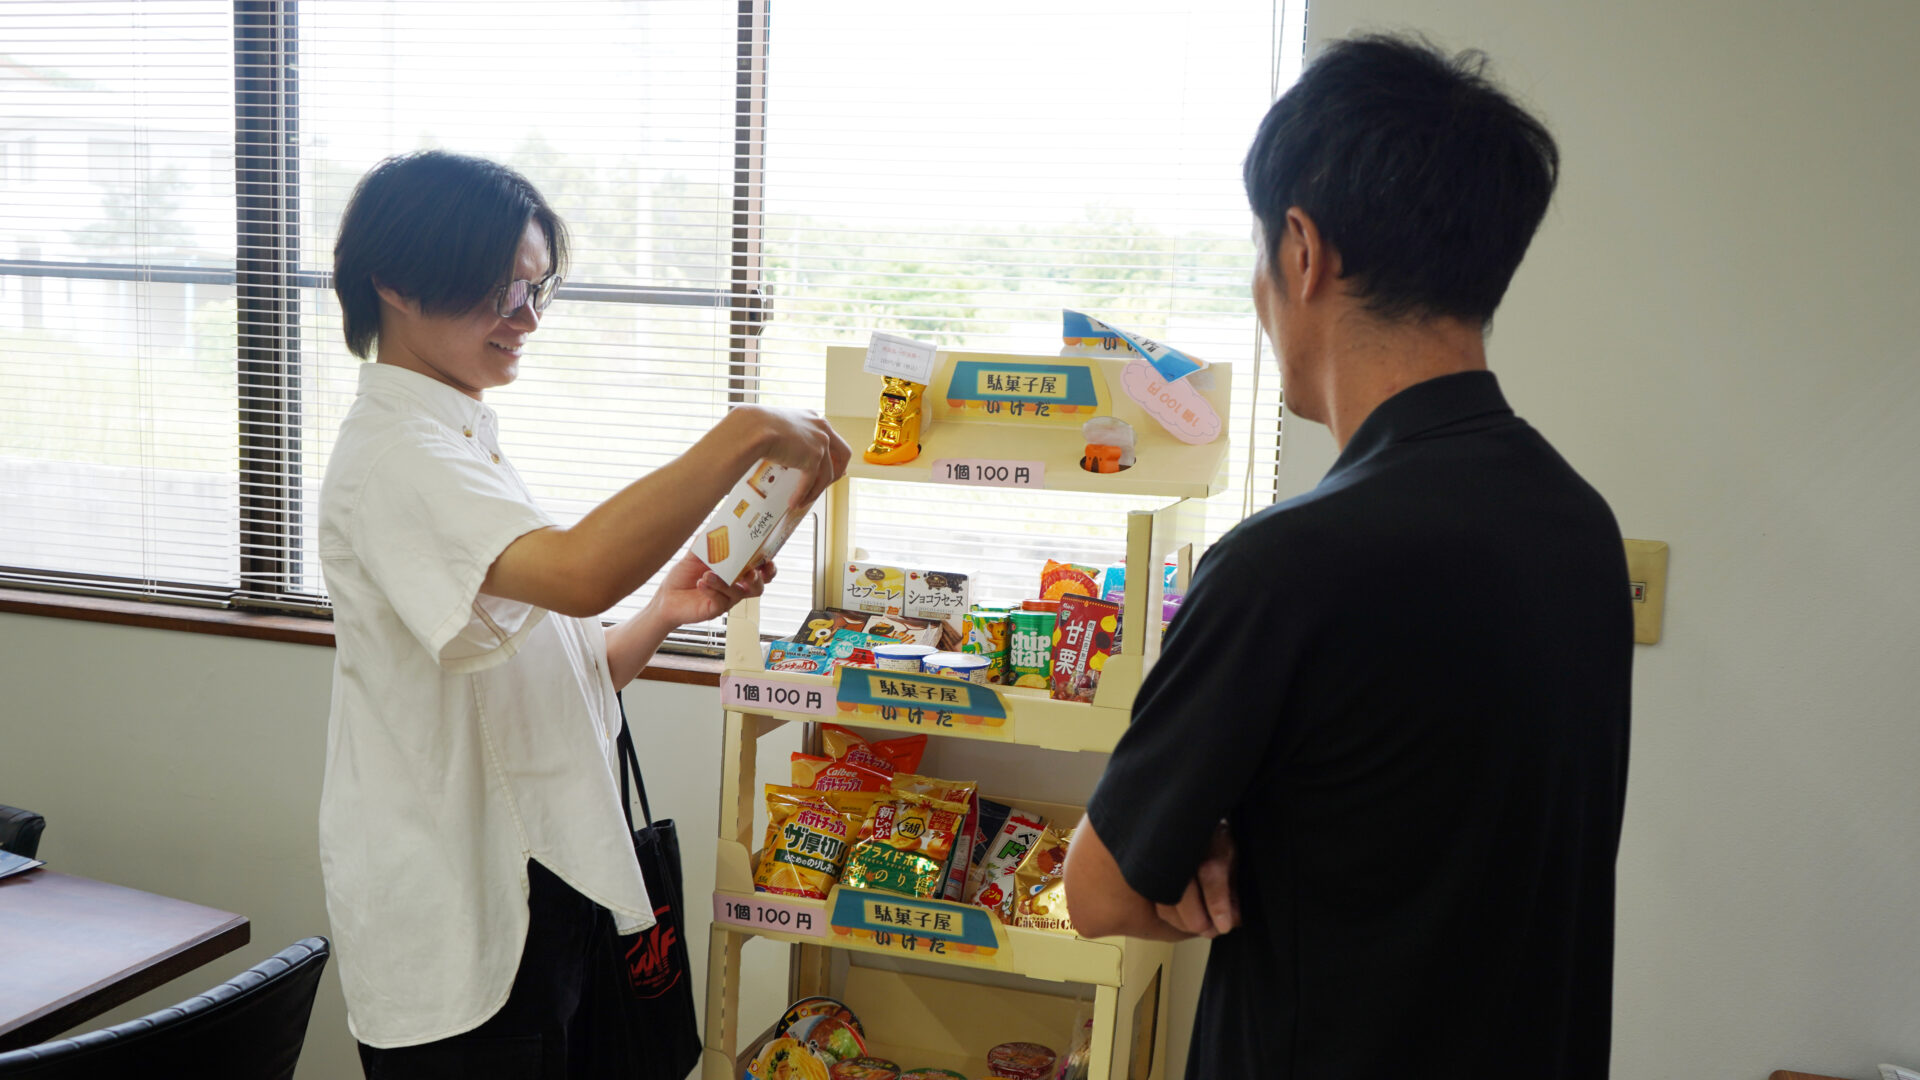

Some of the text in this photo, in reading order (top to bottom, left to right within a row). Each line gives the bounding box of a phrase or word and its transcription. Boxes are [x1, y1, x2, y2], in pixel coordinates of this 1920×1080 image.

[987, 374, 1057, 394] 駄菓子屋
[986, 399, 1051, 417] いけだ
[946, 463, 1030, 484] 1個 100 円
[847, 583, 900, 601] セブーレ
[908, 590, 964, 608] ショコラセーヌ
[1011, 631, 1051, 652] chip
[1055, 619, 1085, 675] 甘栗
[1010, 648, 1050, 668] star
[734, 683, 822, 709] 1個 100 円
[879, 679, 959, 704] 駄菓子屋
[881, 705, 954, 727] いけだ
[826, 767, 858, 777] Calbee
[797, 809, 847, 838] ポテトチップス
[874, 805, 895, 839] 新じゃが
[784, 823, 848, 864] ザ厚切り
[725, 902, 812, 930] 1個 100 円
[874, 904, 952, 932] 駄菓子屋
[1014, 916, 1060, 930] Caramel
[875, 930, 947, 954] いけだ
